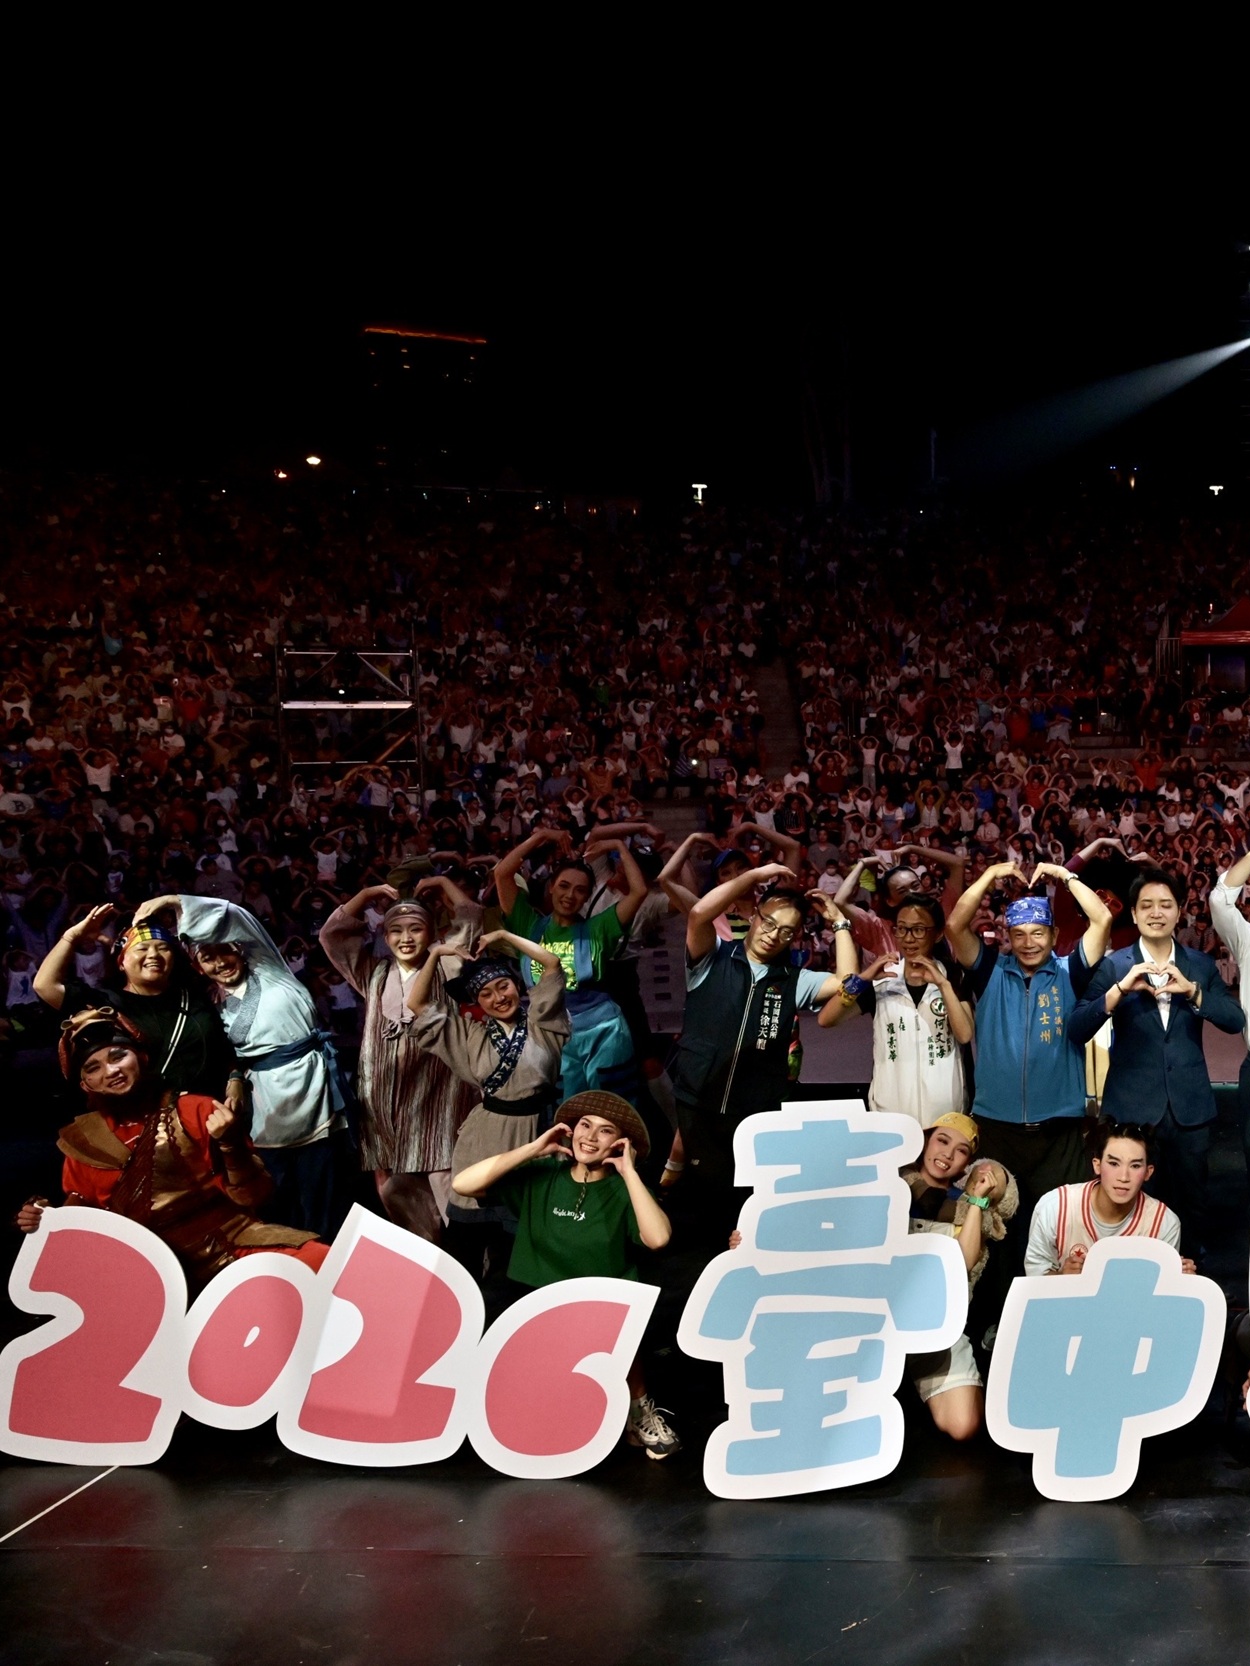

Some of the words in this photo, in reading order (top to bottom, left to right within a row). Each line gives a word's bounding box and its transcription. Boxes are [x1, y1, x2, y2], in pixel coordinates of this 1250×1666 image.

[934, 1018, 947, 1059] 何文海
[8, 1229, 631, 1457] 2026
